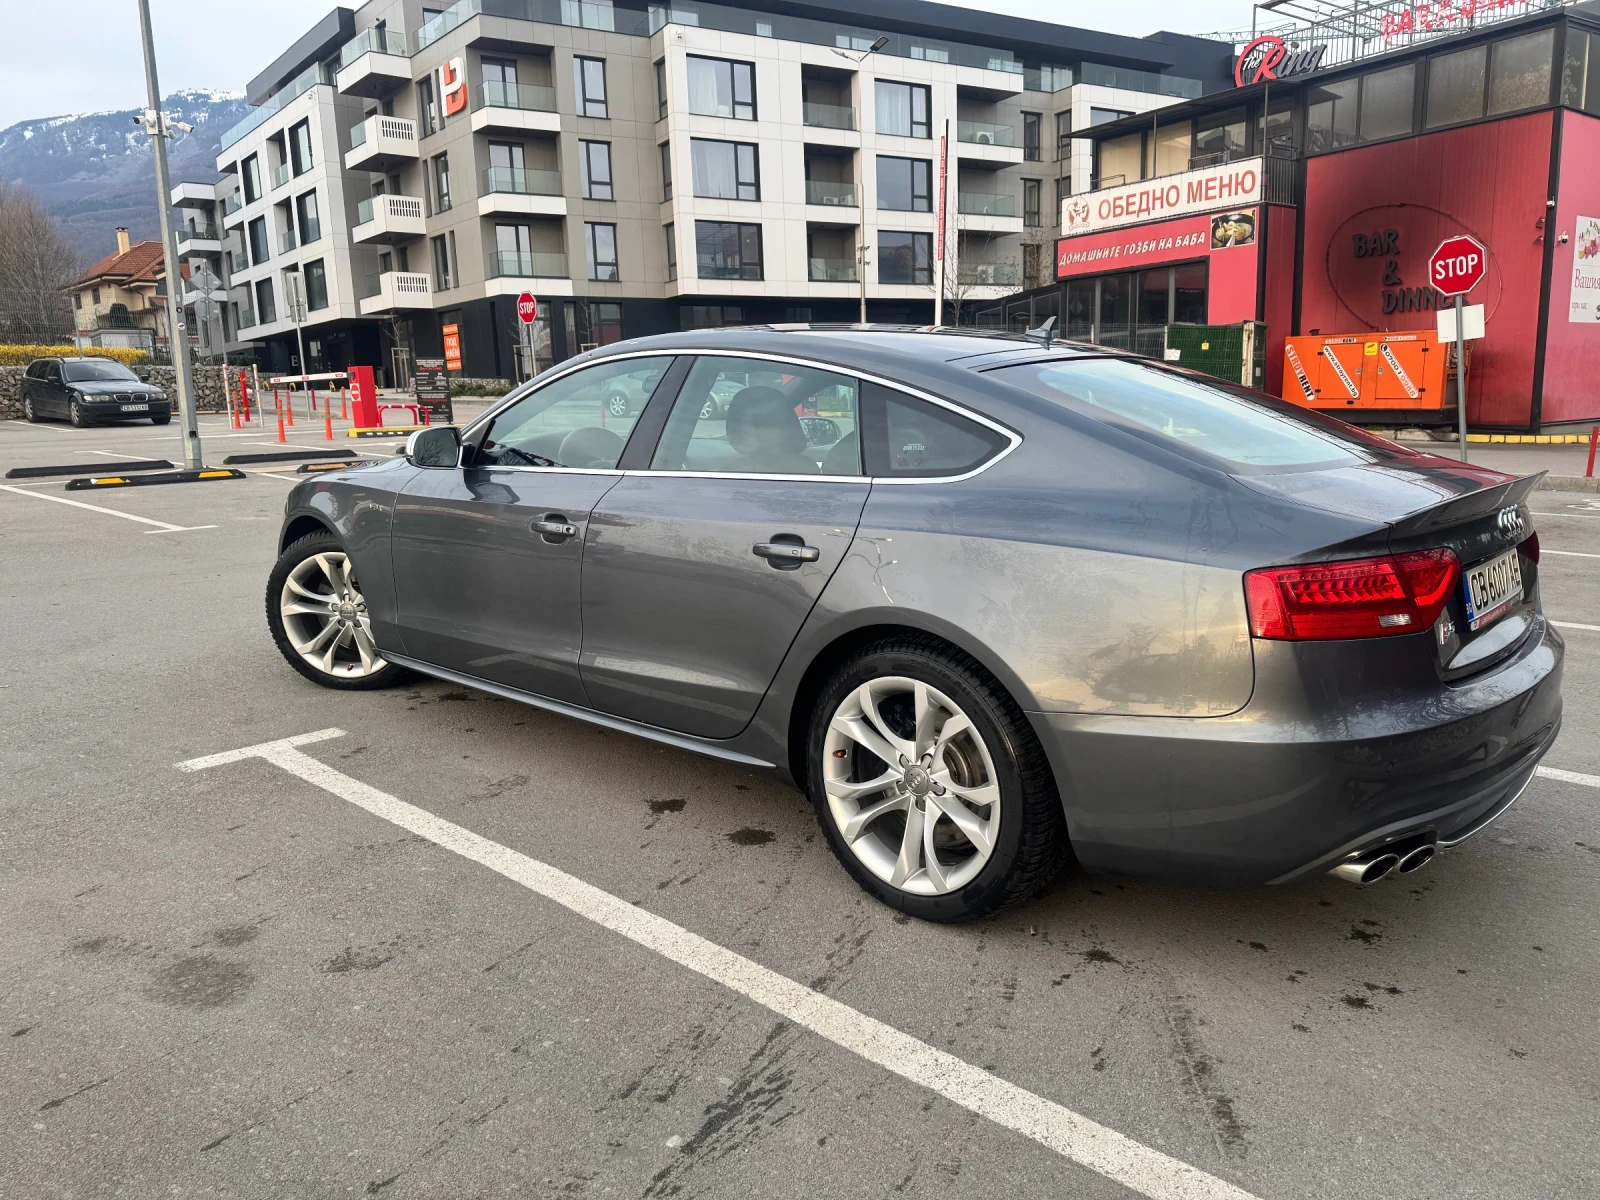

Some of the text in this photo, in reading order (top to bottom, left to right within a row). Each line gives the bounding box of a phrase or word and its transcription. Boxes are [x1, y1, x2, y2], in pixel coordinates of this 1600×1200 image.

[1380, 4, 1433, 40] BAR
[1235, 35, 1328, 87] The Ring
[1098, 169, 1257, 221] ОБЕДНО МЕНЮ
[1058, 231, 1206, 266] ДОМАШНИТЕ ГОЗБИ НА БАБА
[1353, 228, 1400, 258] BAR
[1382, 259, 1402, 286] &
[1435, 253, 1479, 280] STOP
[519, 301, 535, 315] STOP
[1381, 286, 1471, 315] DINN
[445, 347, 460, 358] НАЕМ
[446, 337, 457, 348] ПОД
[1323, 346, 1359, 398] www.stroyrent.bg
[1384, 350, 1400, 371] 0700
[1399, 375, 1416, 398] 9988
[1470, 571, 1489, 611] CB
[1486, 560, 1510, 602] 6007
